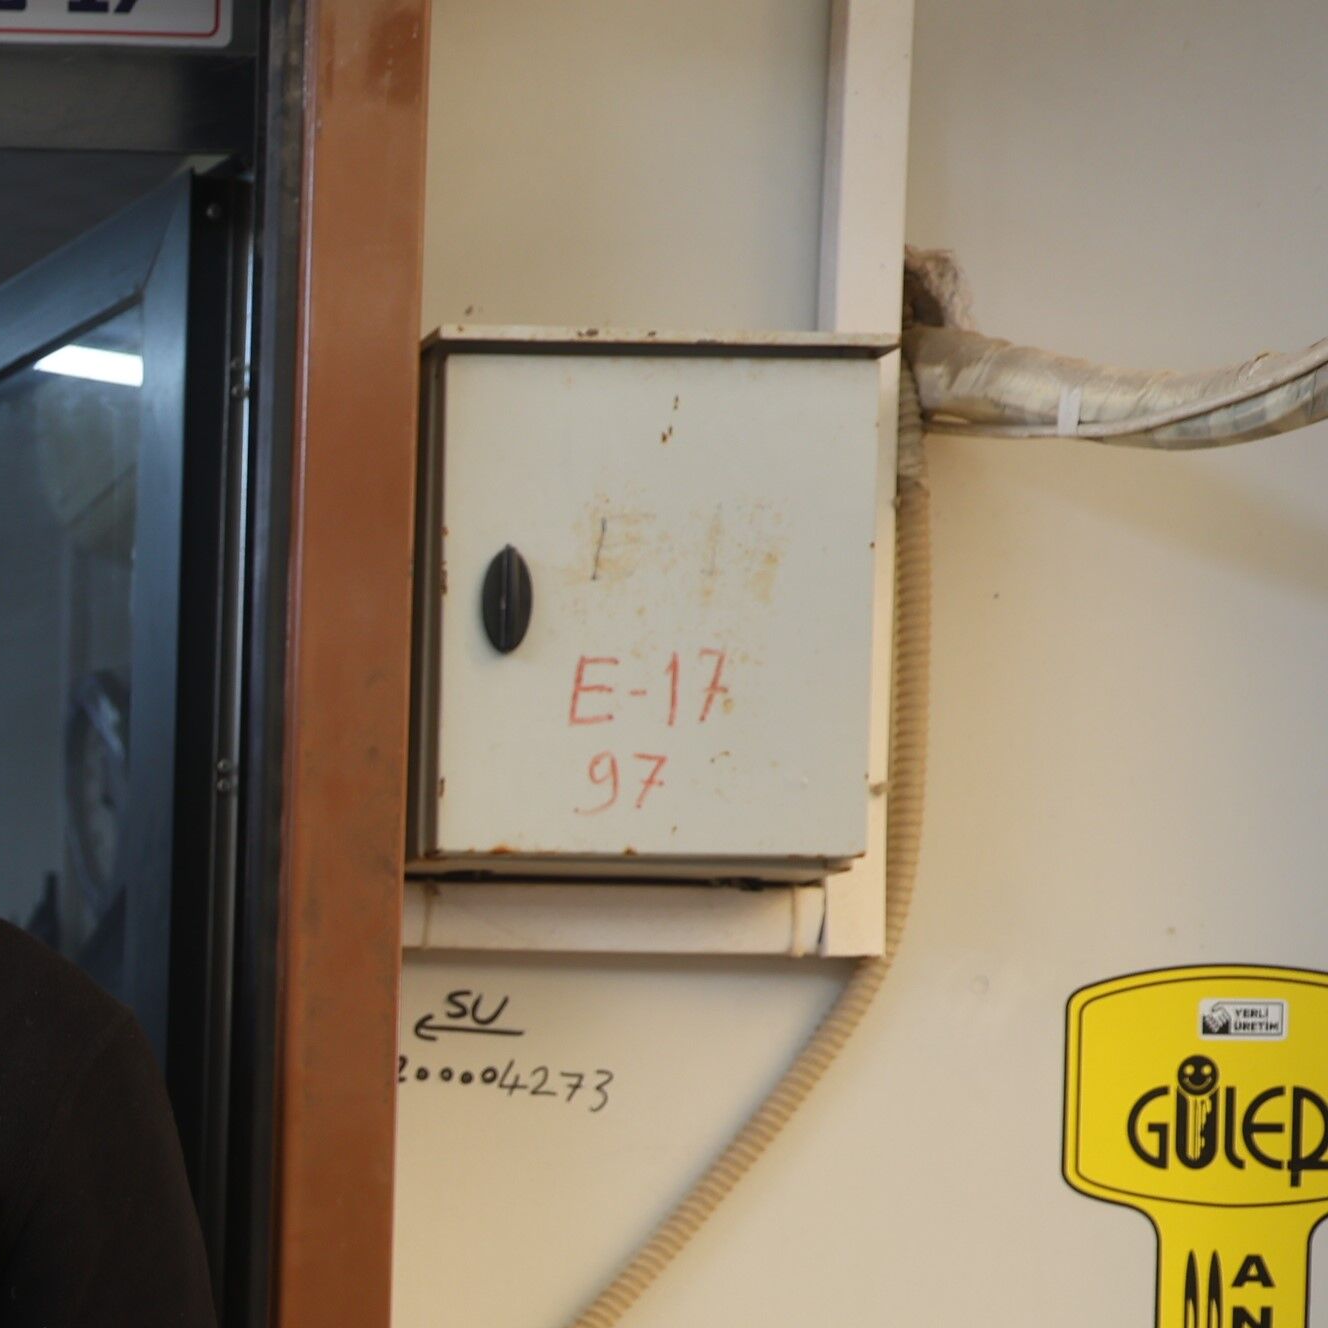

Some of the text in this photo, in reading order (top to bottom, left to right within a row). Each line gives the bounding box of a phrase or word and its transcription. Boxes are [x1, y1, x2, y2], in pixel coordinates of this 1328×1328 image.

[568, 648, 730, 727] E-17
[574, 751, 669, 816] 97
[445, 989, 510, 1026] SU
